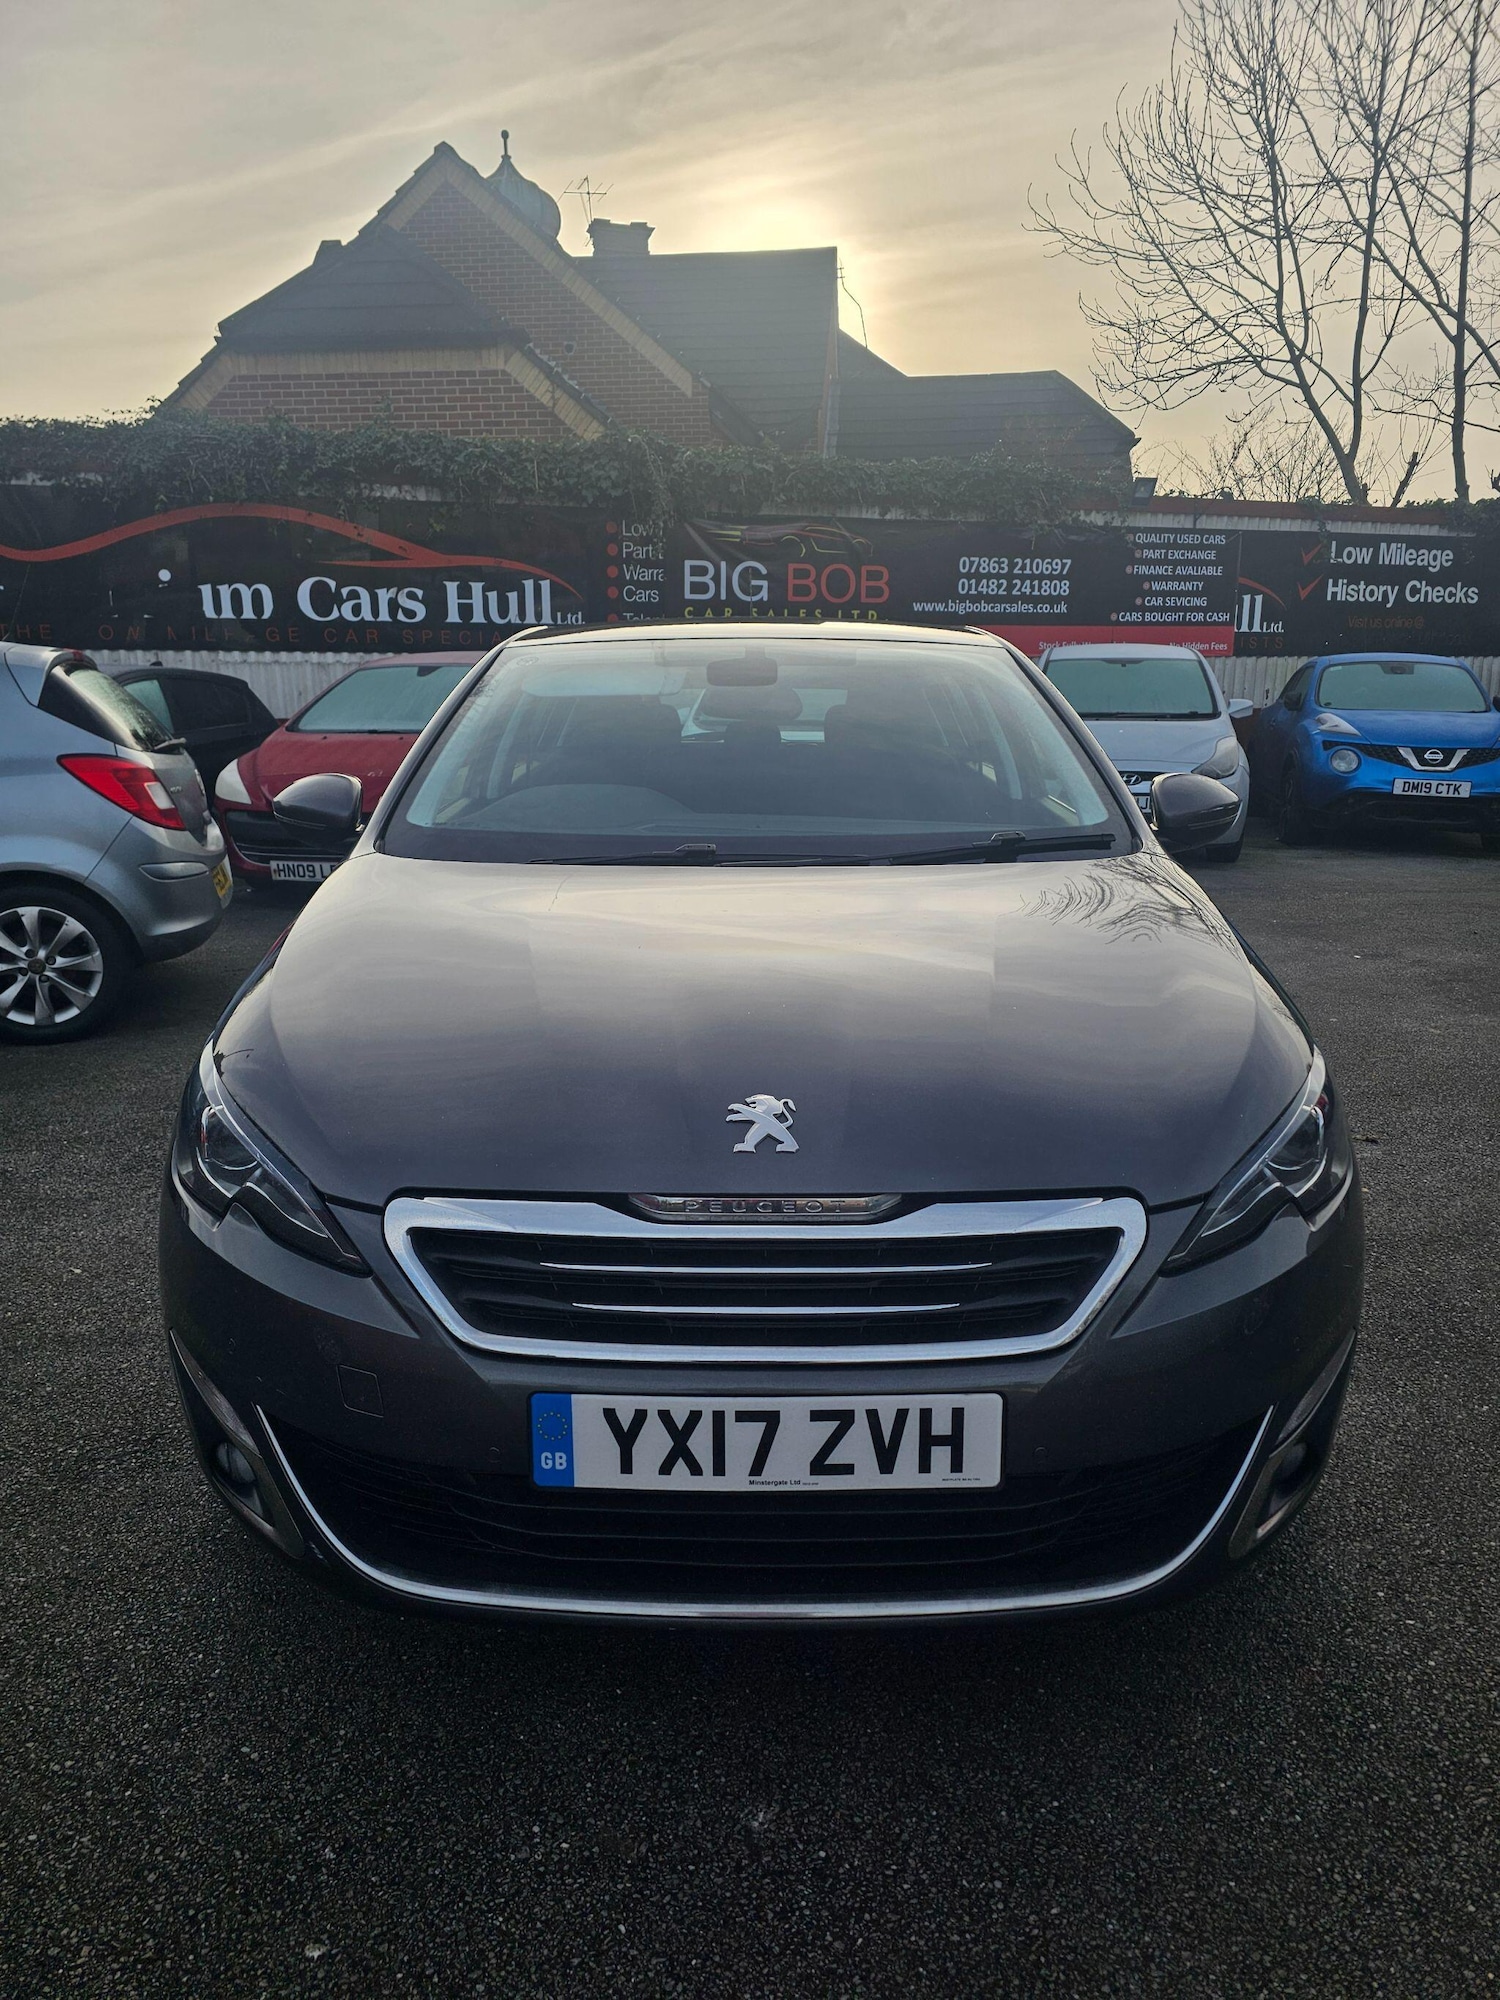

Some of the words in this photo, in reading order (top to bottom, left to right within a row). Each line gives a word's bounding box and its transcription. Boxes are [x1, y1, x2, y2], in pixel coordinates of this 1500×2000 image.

[622, 519, 655, 537] Low
[1135, 533, 1175, 543] QUALITY
[1177, 534, 1200, 543] USED
[1202, 534, 1226, 544] CARS
[622, 542, 654, 560] Part
[1142, 549, 1167, 559] PART
[1167, 550, 1216, 560] EXCHANGE
[1330, 541, 1374, 564] Low
[1379, 542, 1453, 572] Mileage
[959, 556, 1009, 573] 07863
[1013, 558, 1072, 575] 210697
[1133, 565, 1173, 575] FINANCE
[1175, 565, 1223, 576] AVALIABLE
[684, 559, 769, 602] BIG
[787, 562, 890, 603] BOB
[957, 578, 1008, 595] 01482
[1011, 579, 1070, 596] 241808
[1151, 581, 1203, 590] WARRANTY
[296, 576, 427, 623] Cars
[442, 578, 555, 625] Hull
[557, 611, 586, 625] Ltd.
[622, 585, 660, 602] Cars
[1327, 578, 1400, 608] History
[1405, 580, 1479, 604] Checks
[913, 599, 1068, 615] www.bigbobcarsales.co.uk
[1144, 597, 1162, 606] CAR
[1163, 597, 1207, 607] SEVICING
[684, 606, 733, 618] CAR
[1118, 612, 1143, 622] CARS
[1144, 612, 1184, 622] BOUGHT
[1185, 612, 1205, 622] FOR
[1206, 612, 1230, 622] CASH
[1263, 621, 1285, 633] Ltd.
[323, 627, 379, 643] CAR
[402, 629, 502, 645] SPECIA
[1182, 642, 1210, 650] Hidden
[1211, 642, 1228, 650] Fees
[1402, 781, 1432, 794] DM19
[1436, 783, 1462, 795] CTK
[276, 863, 316, 878] HN09
[684, 1199, 845, 1213] PEUGEOT
[602, 1407, 781, 1477] YX17
[809, 1406, 965, 1476] ZVH
[540, 1451, 567, 1469] GB
[749, 1479, 789, 1487] Minstergate
